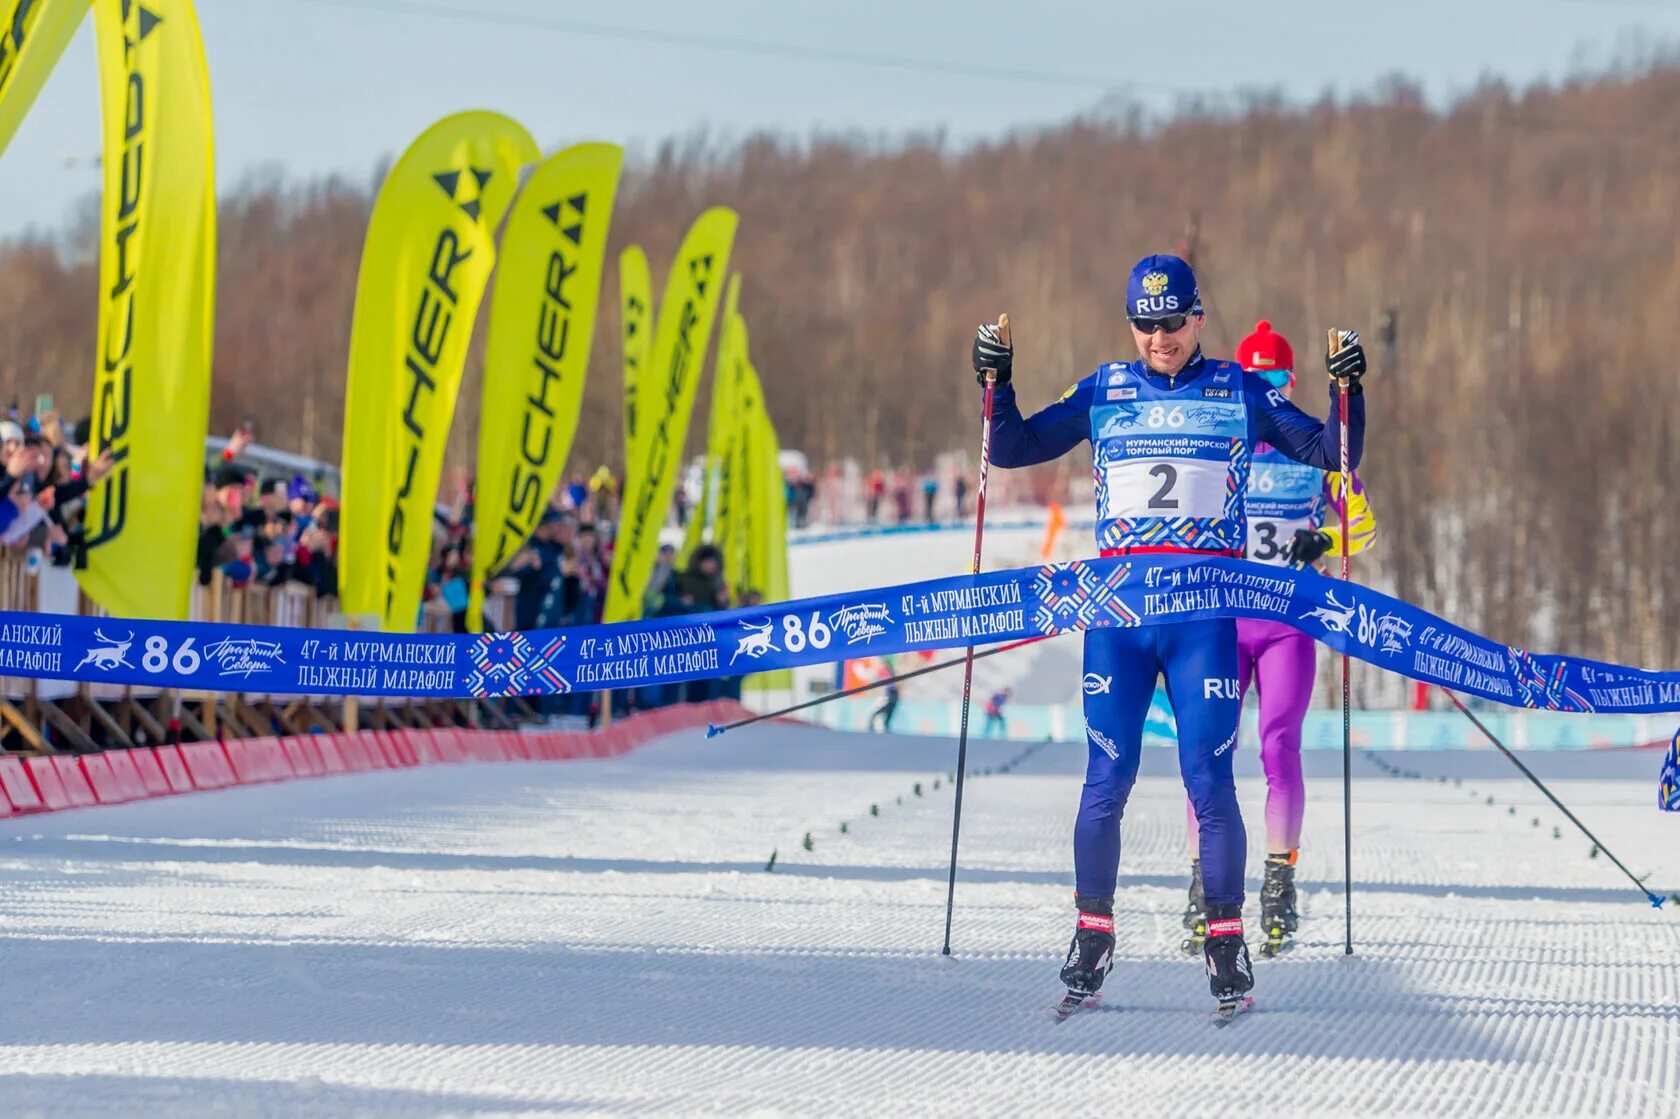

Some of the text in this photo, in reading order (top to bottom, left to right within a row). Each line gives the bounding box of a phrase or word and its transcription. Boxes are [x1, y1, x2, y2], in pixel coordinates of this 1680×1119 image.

[1136, 295, 1179, 314] RUS
[1147, 405, 1185, 428] 86
[1126, 437, 1230, 450] МУРМАНСКИЙ МОРСКОЙ
[1126, 446, 1197, 455] ТОРГОВЫЙ ПОРТ
[1147, 463, 1179, 509] 2
[1233, 524, 1240, 539] 2
[1253, 521, 1279, 561] 3
[1144, 566, 1296, 598] 47-й МУРМАНСКИЙ
[901, 579, 1022, 616] 47-й МУРМАНСКИЙ
[1144, 584, 1291, 616] ЛЫЖНЫЙ МАРАФОН
[783, 611, 831, 653] 86
[828, 602, 895, 632] Праздник
[904, 609, 1025, 644] ЛЫЖНЫЙ МАРАФОН
[1358, 603, 1377, 648] 86
[579, 622, 717, 660] 47-й МУРМАНСКИЙ
[846, 621, 888, 645] Севера
[1418, 625, 1445, 650] 47-й
[142, 635, 200, 675] 86
[203, 635, 286, 664] Праздник
[300, 640, 457, 665] 47-й МУРМАНСКИЙ
[220, 655, 272, 679] Севера
[297, 665, 456, 690] ЛЫЖНЫЙ МАРАФОН
[575, 648, 719, 683] ЛЫЖНЫЙ МАРАФОН
[1413, 650, 1513, 697] ЛЫЖНЫЙ МАРАФОН
[1589, 680, 1655, 707] ЛЫЖНЫЙ
